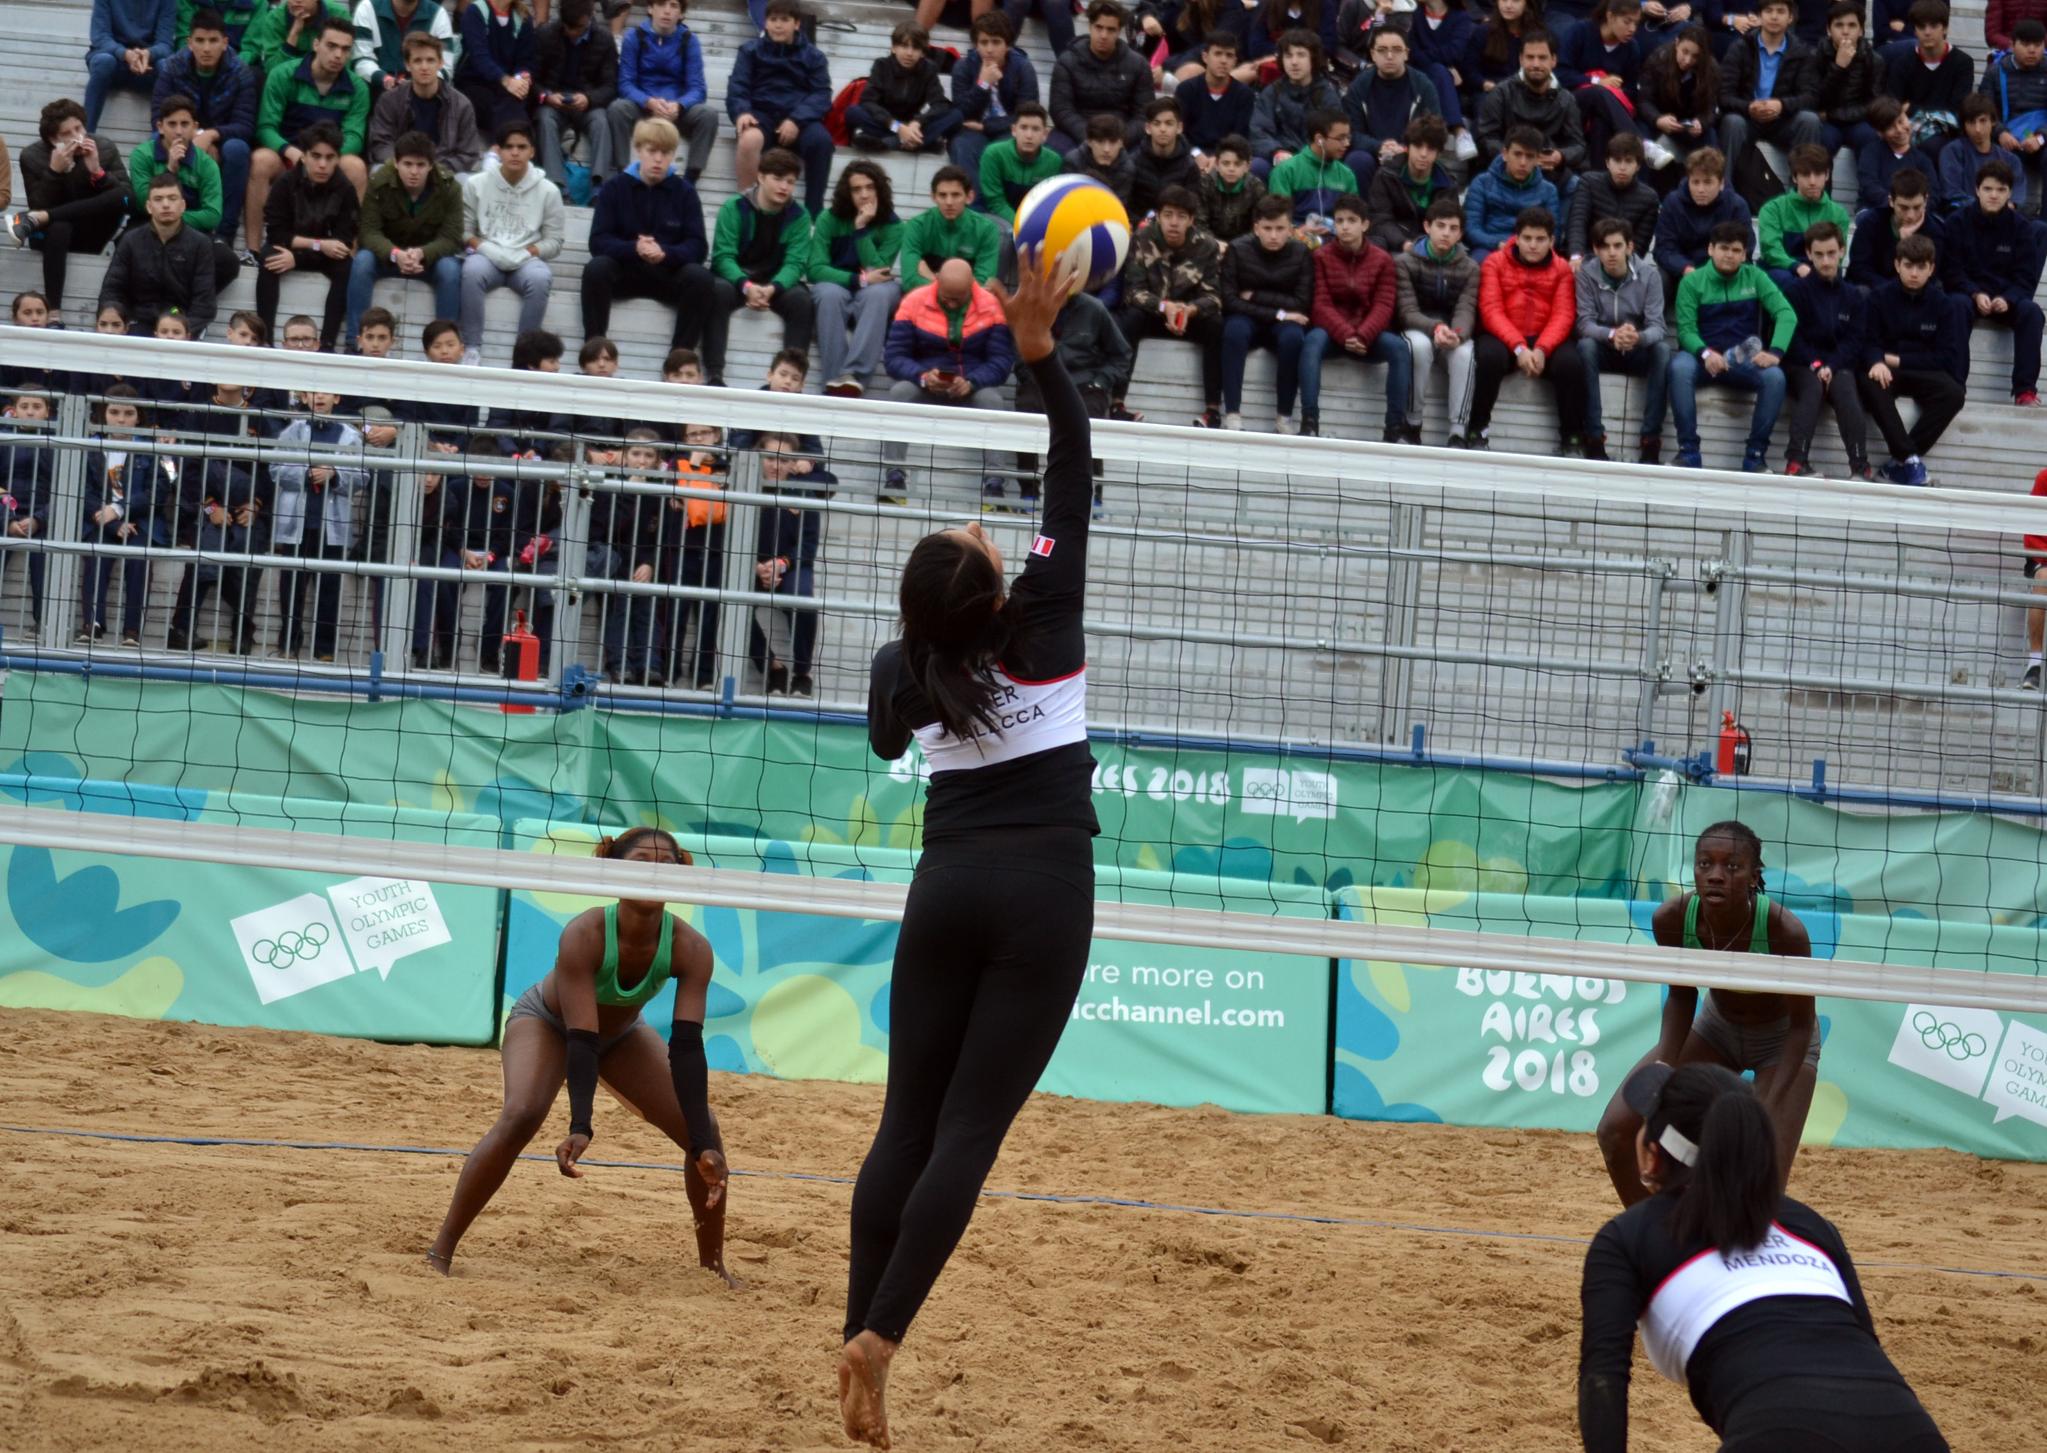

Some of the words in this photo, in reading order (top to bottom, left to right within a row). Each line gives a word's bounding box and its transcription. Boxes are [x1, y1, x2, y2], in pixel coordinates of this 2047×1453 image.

[992, 686, 1019, 707] ER
[1147, 766, 1231, 806] 2018
[349, 881, 412, 908] YOUTH
[351, 897, 428, 932] OLYMPIC
[367, 919, 430, 949] GAMES
[1083, 964, 1120, 984] re
[1132, 966, 1214, 988] more
[1225, 970, 1264, 990] on
[1481, 1001, 1601, 1047] AIRES
[2021, 1041, 2047, 1066] YO
[1482, 1045, 1600, 1097] 2018
[2006, 1081, 2047, 1109] GAM
[1723, 1253, 1834, 1272] MENDOZA
